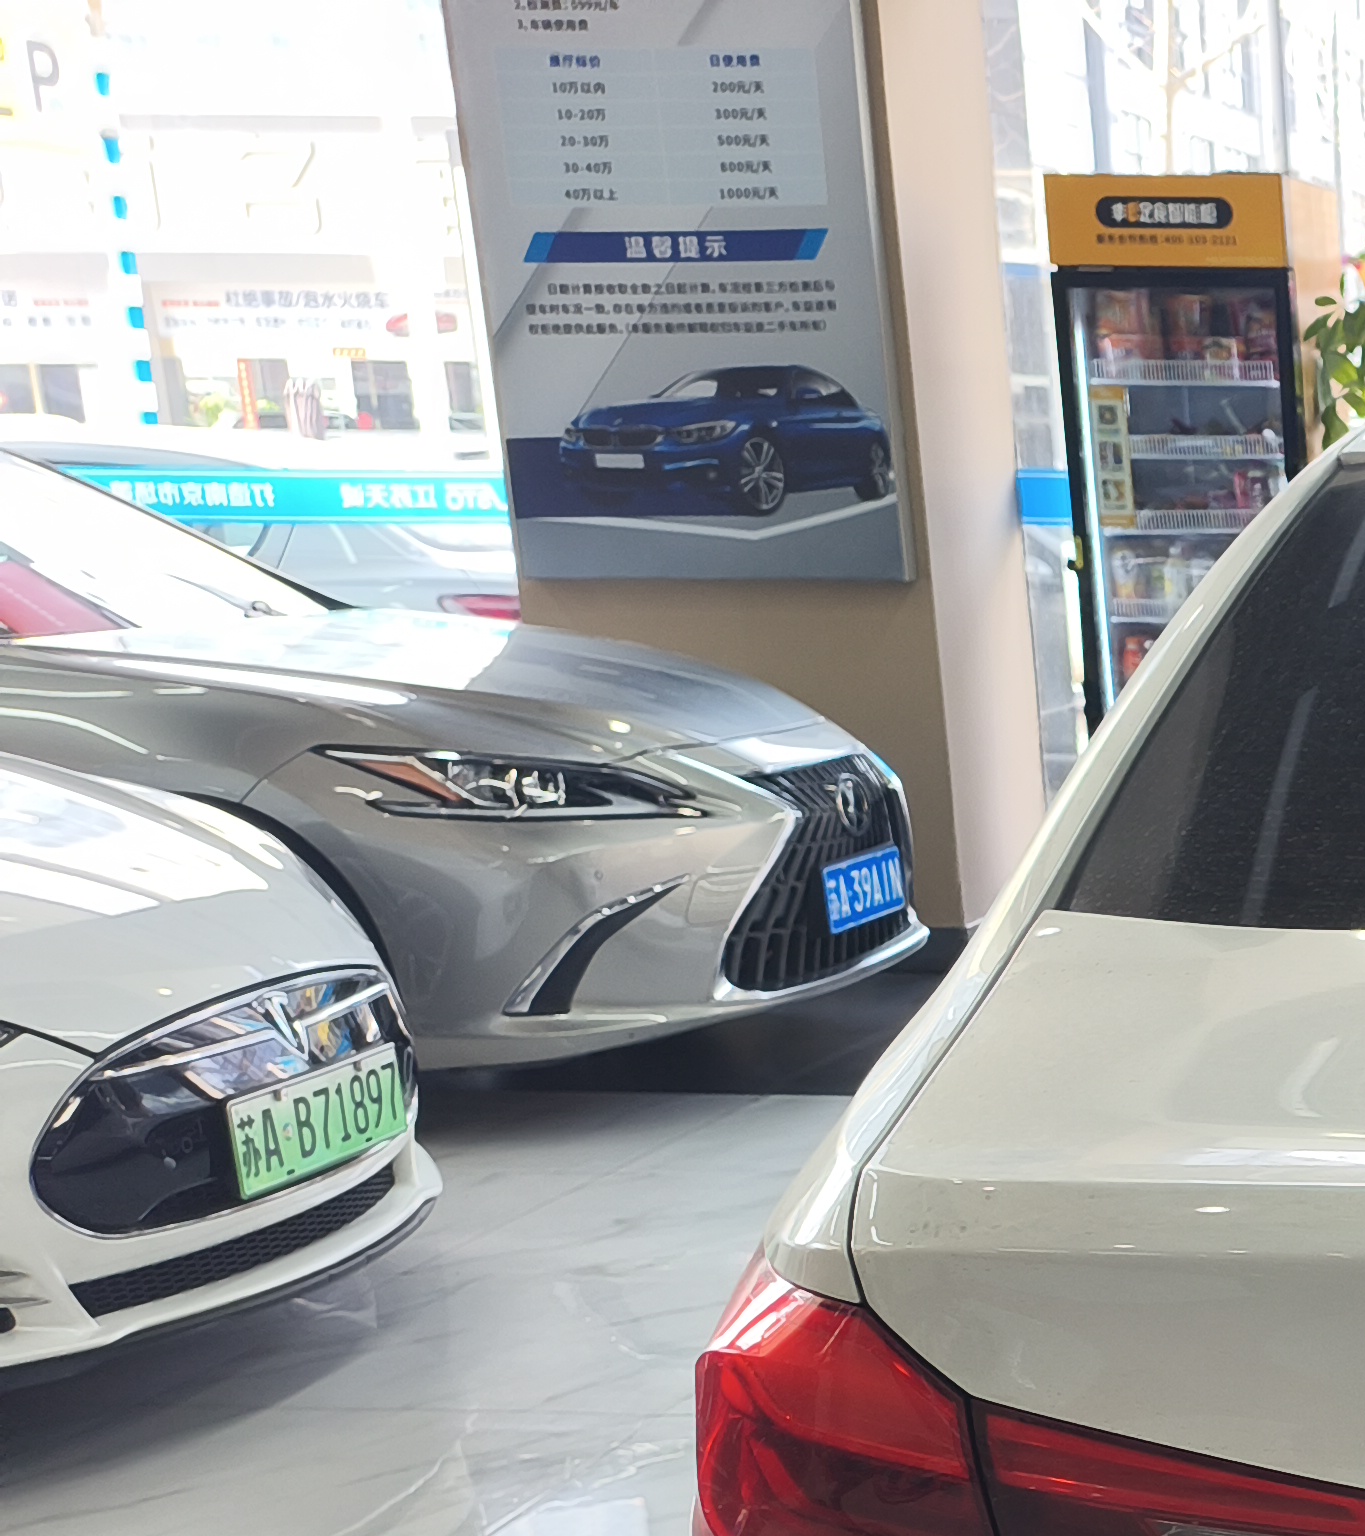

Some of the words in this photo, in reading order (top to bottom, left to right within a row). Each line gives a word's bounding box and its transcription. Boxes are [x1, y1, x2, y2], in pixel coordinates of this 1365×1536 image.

[551, 81, 606, 95] 10万以内
[711, 80, 766, 95] 200元/天
[557, 107, 607, 122] 10-20万
[714, 107, 768, 121] 300元/天
[560, 134, 610, 149] 20-30万
[717, 133, 771, 148] 500元/天
[563, 160, 613, 175] 30-40万
[564, 187, 619, 202] 40万以上
[719, 185, 780, 201] 1000元/天
[624, 235, 728, 259] 温馨提示
